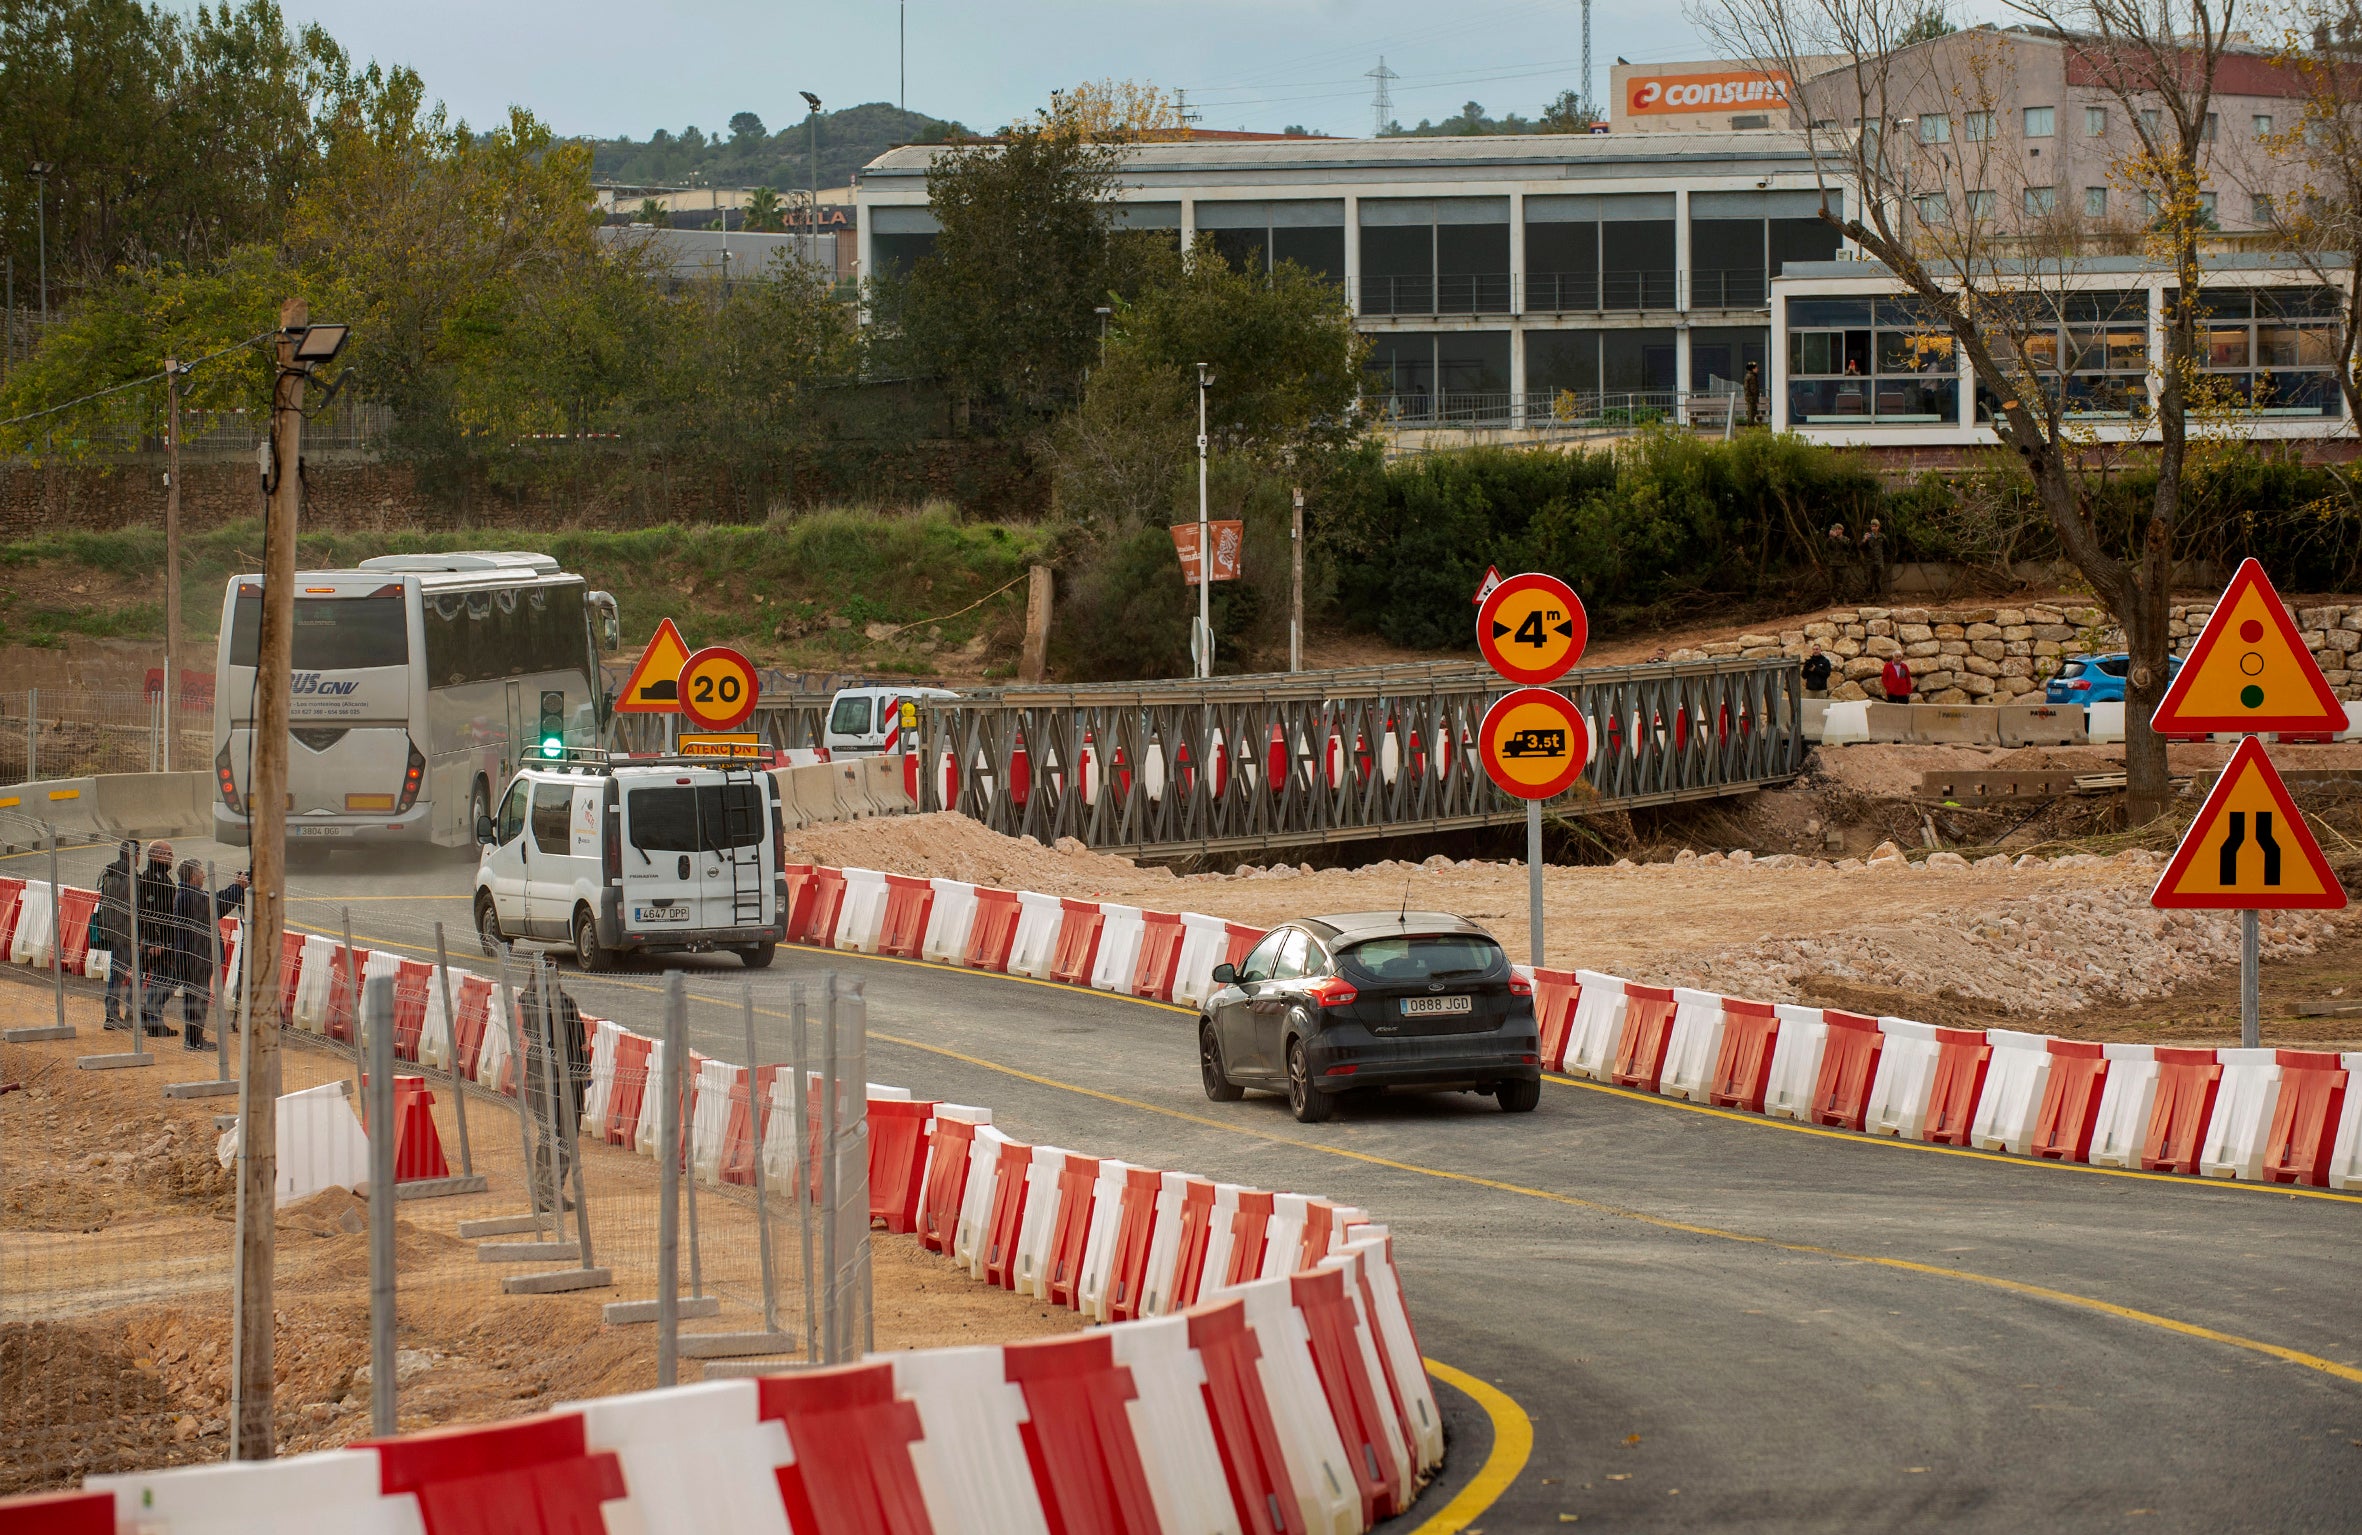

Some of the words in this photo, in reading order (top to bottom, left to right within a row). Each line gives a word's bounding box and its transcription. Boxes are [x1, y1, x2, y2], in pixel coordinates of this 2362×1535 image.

[1665, 80, 1787, 106] consum
[318, 682, 359, 694] GNV
[694, 676, 740, 702] 20
[1526, 734, 1560, 749] 3,5t
[643, 908, 666, 919] 4647
[669, 908, 687, 918] DPP
[1410, 998, 1442, 1012] 0888
[1446, 997, 1469, 1010] JGD
